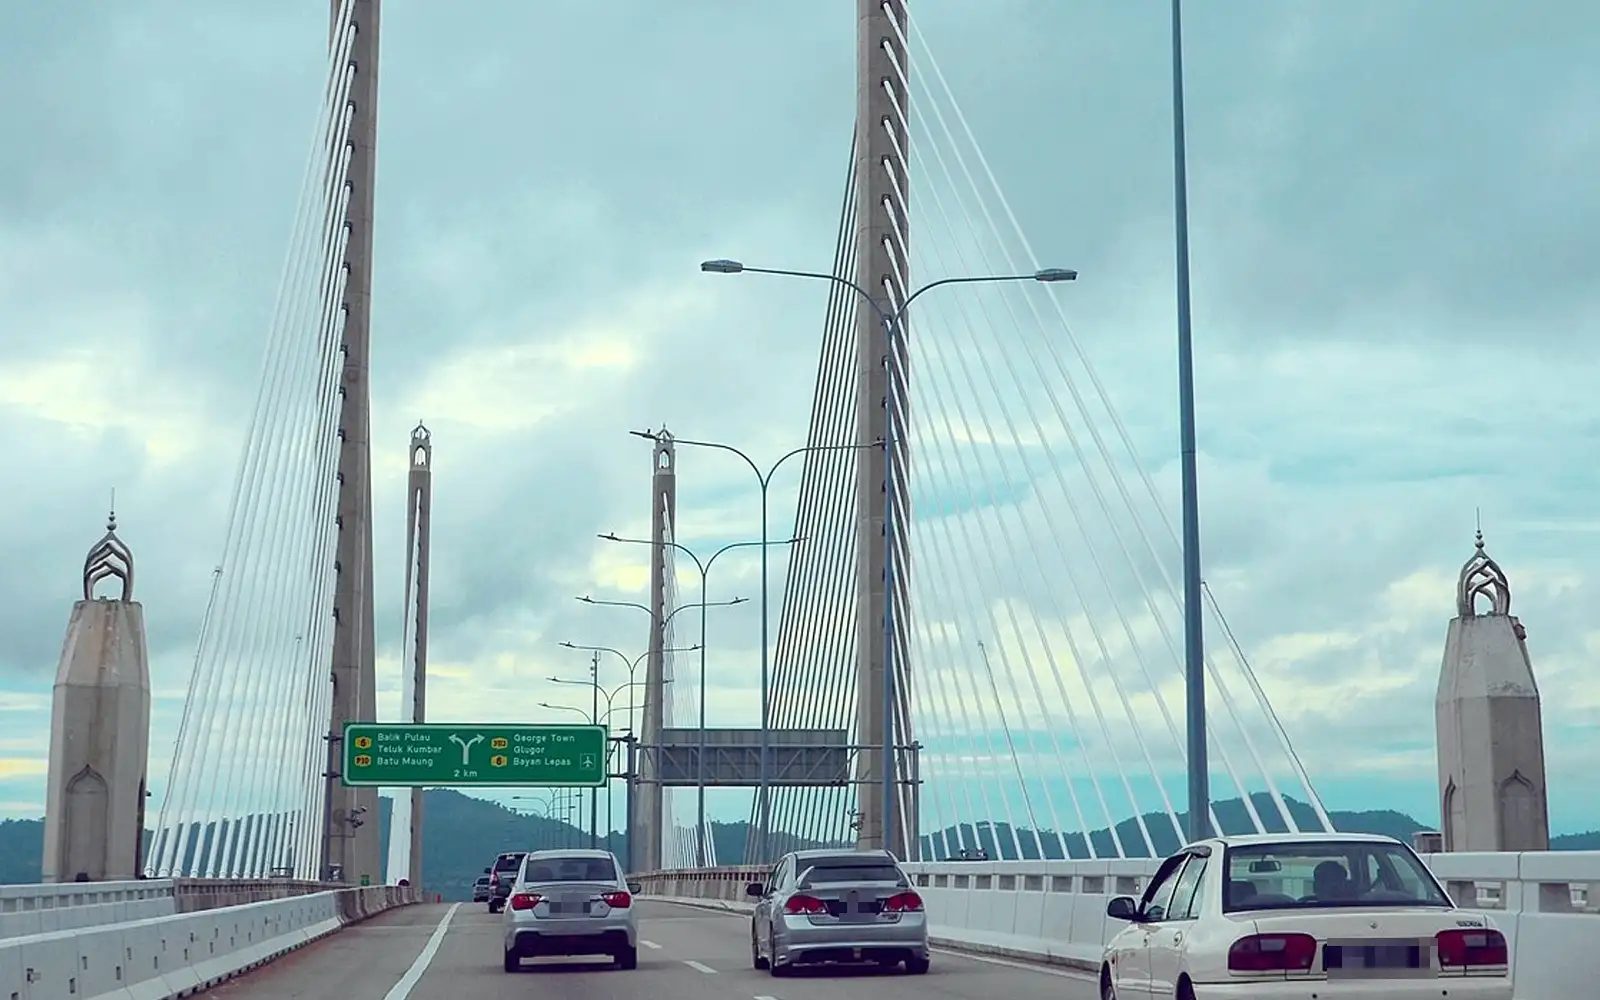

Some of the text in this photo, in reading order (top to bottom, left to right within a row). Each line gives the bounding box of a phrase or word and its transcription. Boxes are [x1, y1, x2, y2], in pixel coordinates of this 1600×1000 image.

[377, 733, 431, 742] Balik Pulau
[513, 734, 546, 744] George
[551, 734, 575, 743] Town
[378, 745, 442, 754] Teluk Kumbar
[513, 746, 545, 756] Glugor
[377, 757, 434, 767] Batu Maung
[513, 757, 572, 767] Bayan Lepas
[453, 769, 478, 778] 2 km
